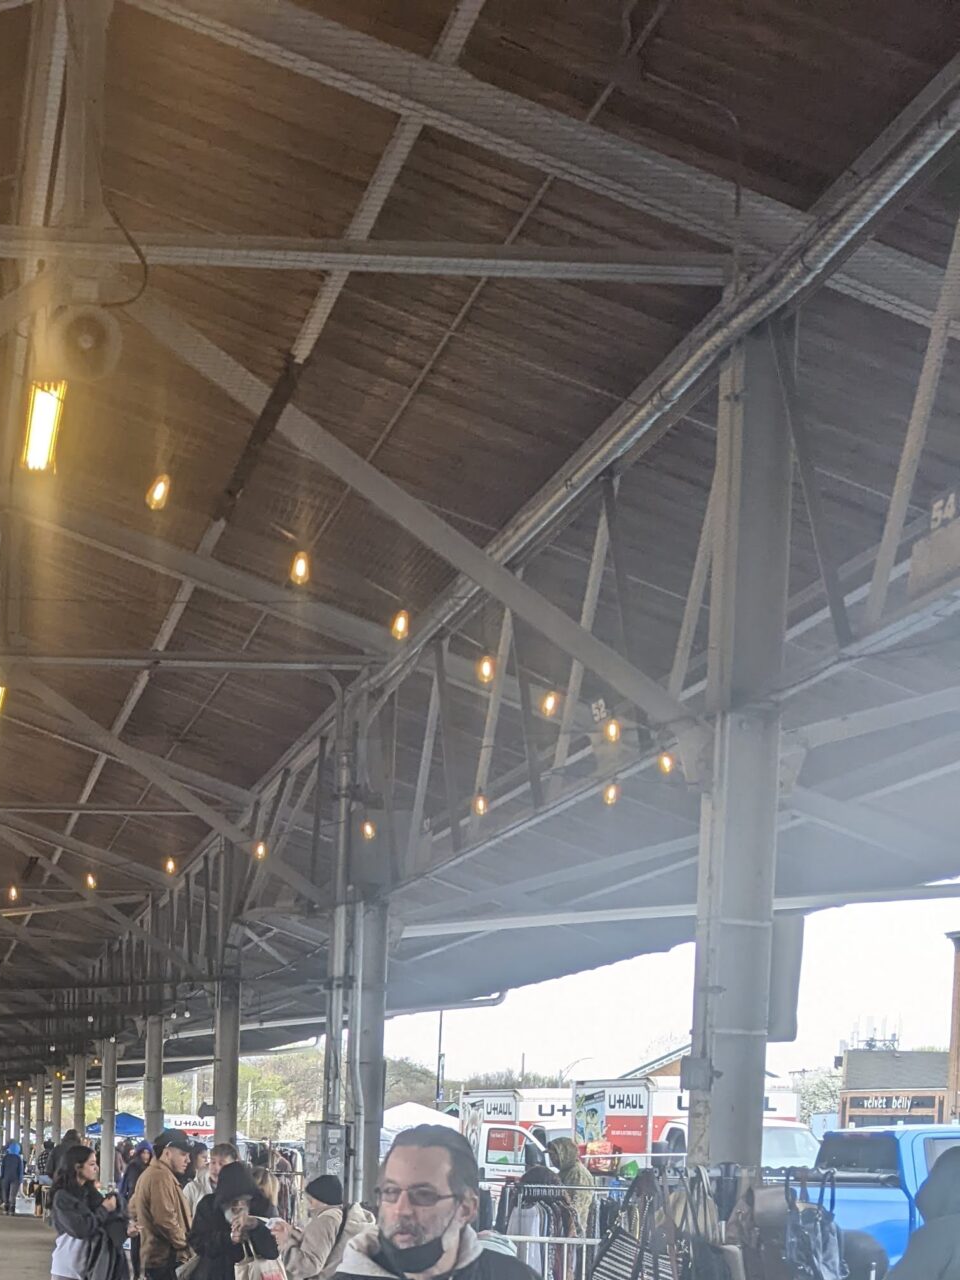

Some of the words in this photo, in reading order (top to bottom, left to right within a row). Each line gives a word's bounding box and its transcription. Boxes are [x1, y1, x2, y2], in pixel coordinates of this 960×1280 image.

[931, 493, 956, 529] 54
[863, 1096, 887, 1109] velvet
[891, 1095, 912, 1113] belly
